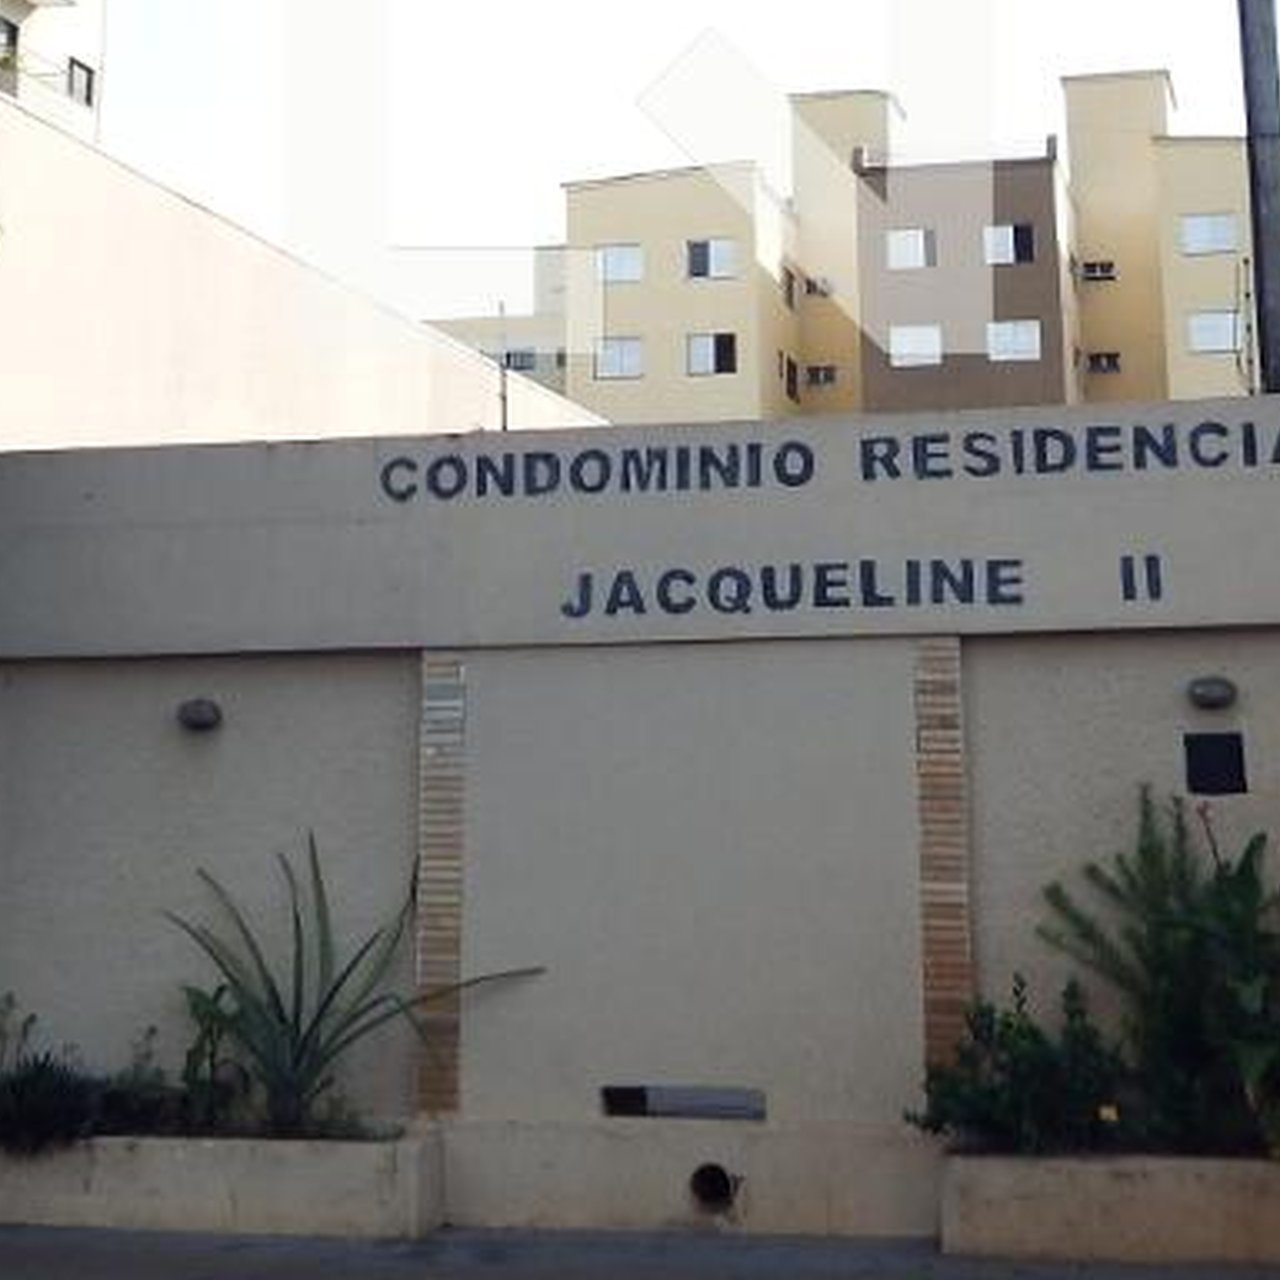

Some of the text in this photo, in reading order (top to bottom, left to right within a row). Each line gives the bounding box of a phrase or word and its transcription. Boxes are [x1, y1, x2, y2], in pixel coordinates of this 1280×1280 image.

[379, 441, 815, 503] CONDOMINIO
[560, 555, 1163, 618] JACQUELINE II
